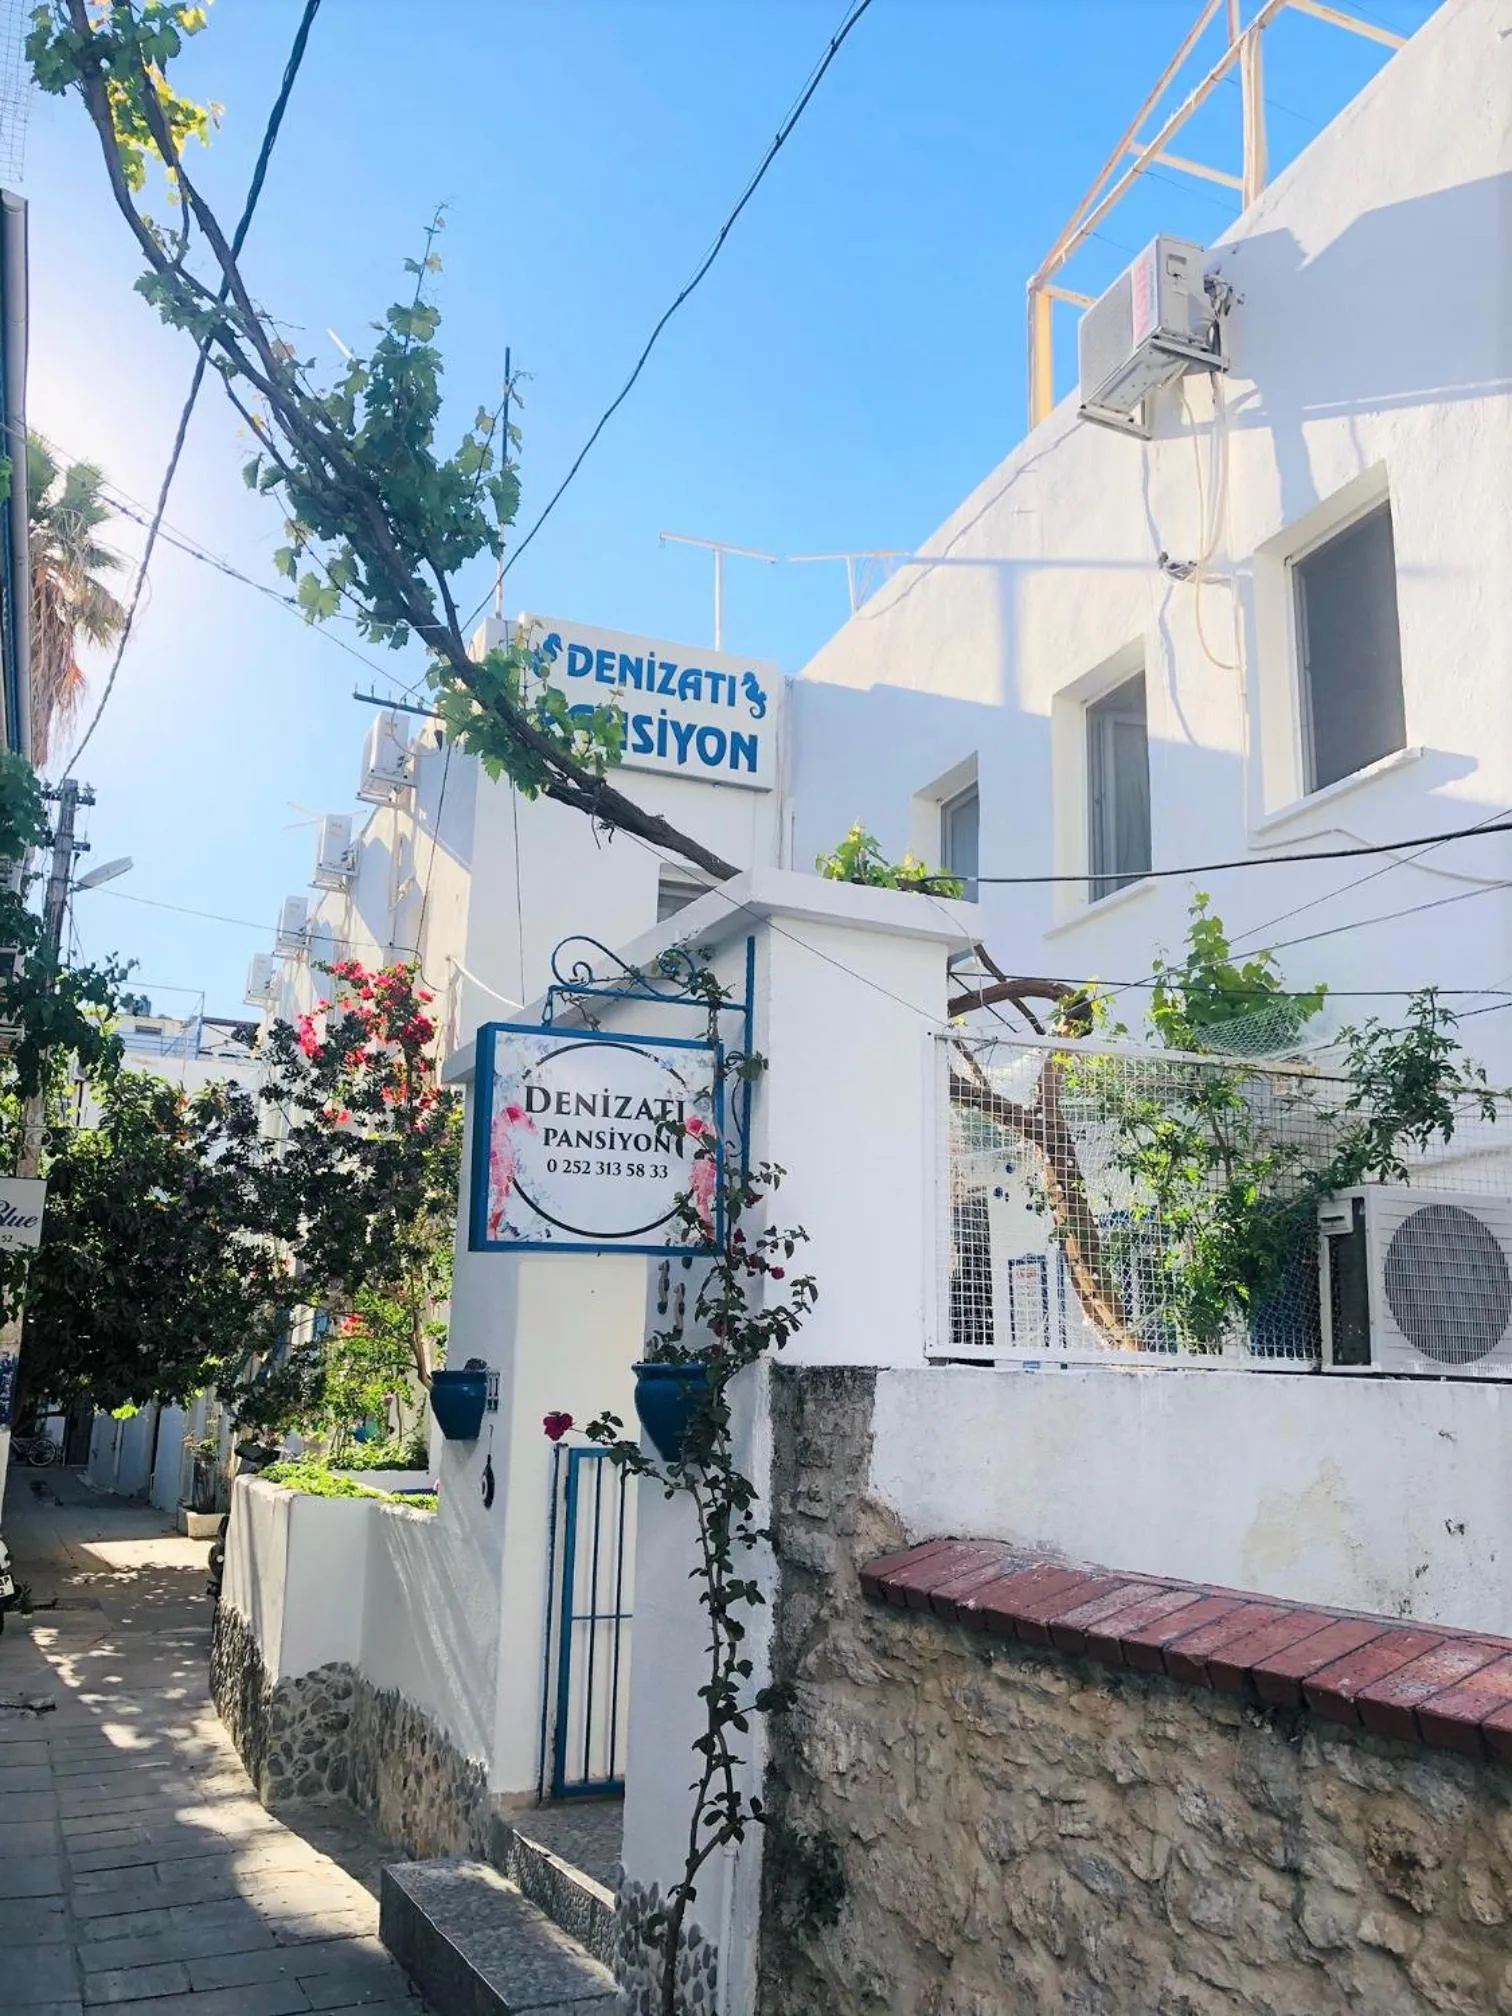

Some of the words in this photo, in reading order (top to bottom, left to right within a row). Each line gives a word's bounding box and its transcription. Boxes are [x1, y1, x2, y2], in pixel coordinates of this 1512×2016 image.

[567, 643, 736, 707] DENİZATI
[540, 703, 759, 773] SİYON
[525, 1085, 685, 1123] DENİZATI
[543, 1127, 671, 1155] PANSİYON
[547, 1158, 557, 1173] 0
[563, 1160, 591, 1175] 252
[595, 1161, 621, 1176] 313
[626, 1163, 645, 1178] 58
[650, 1164, 668, 1179] 33
